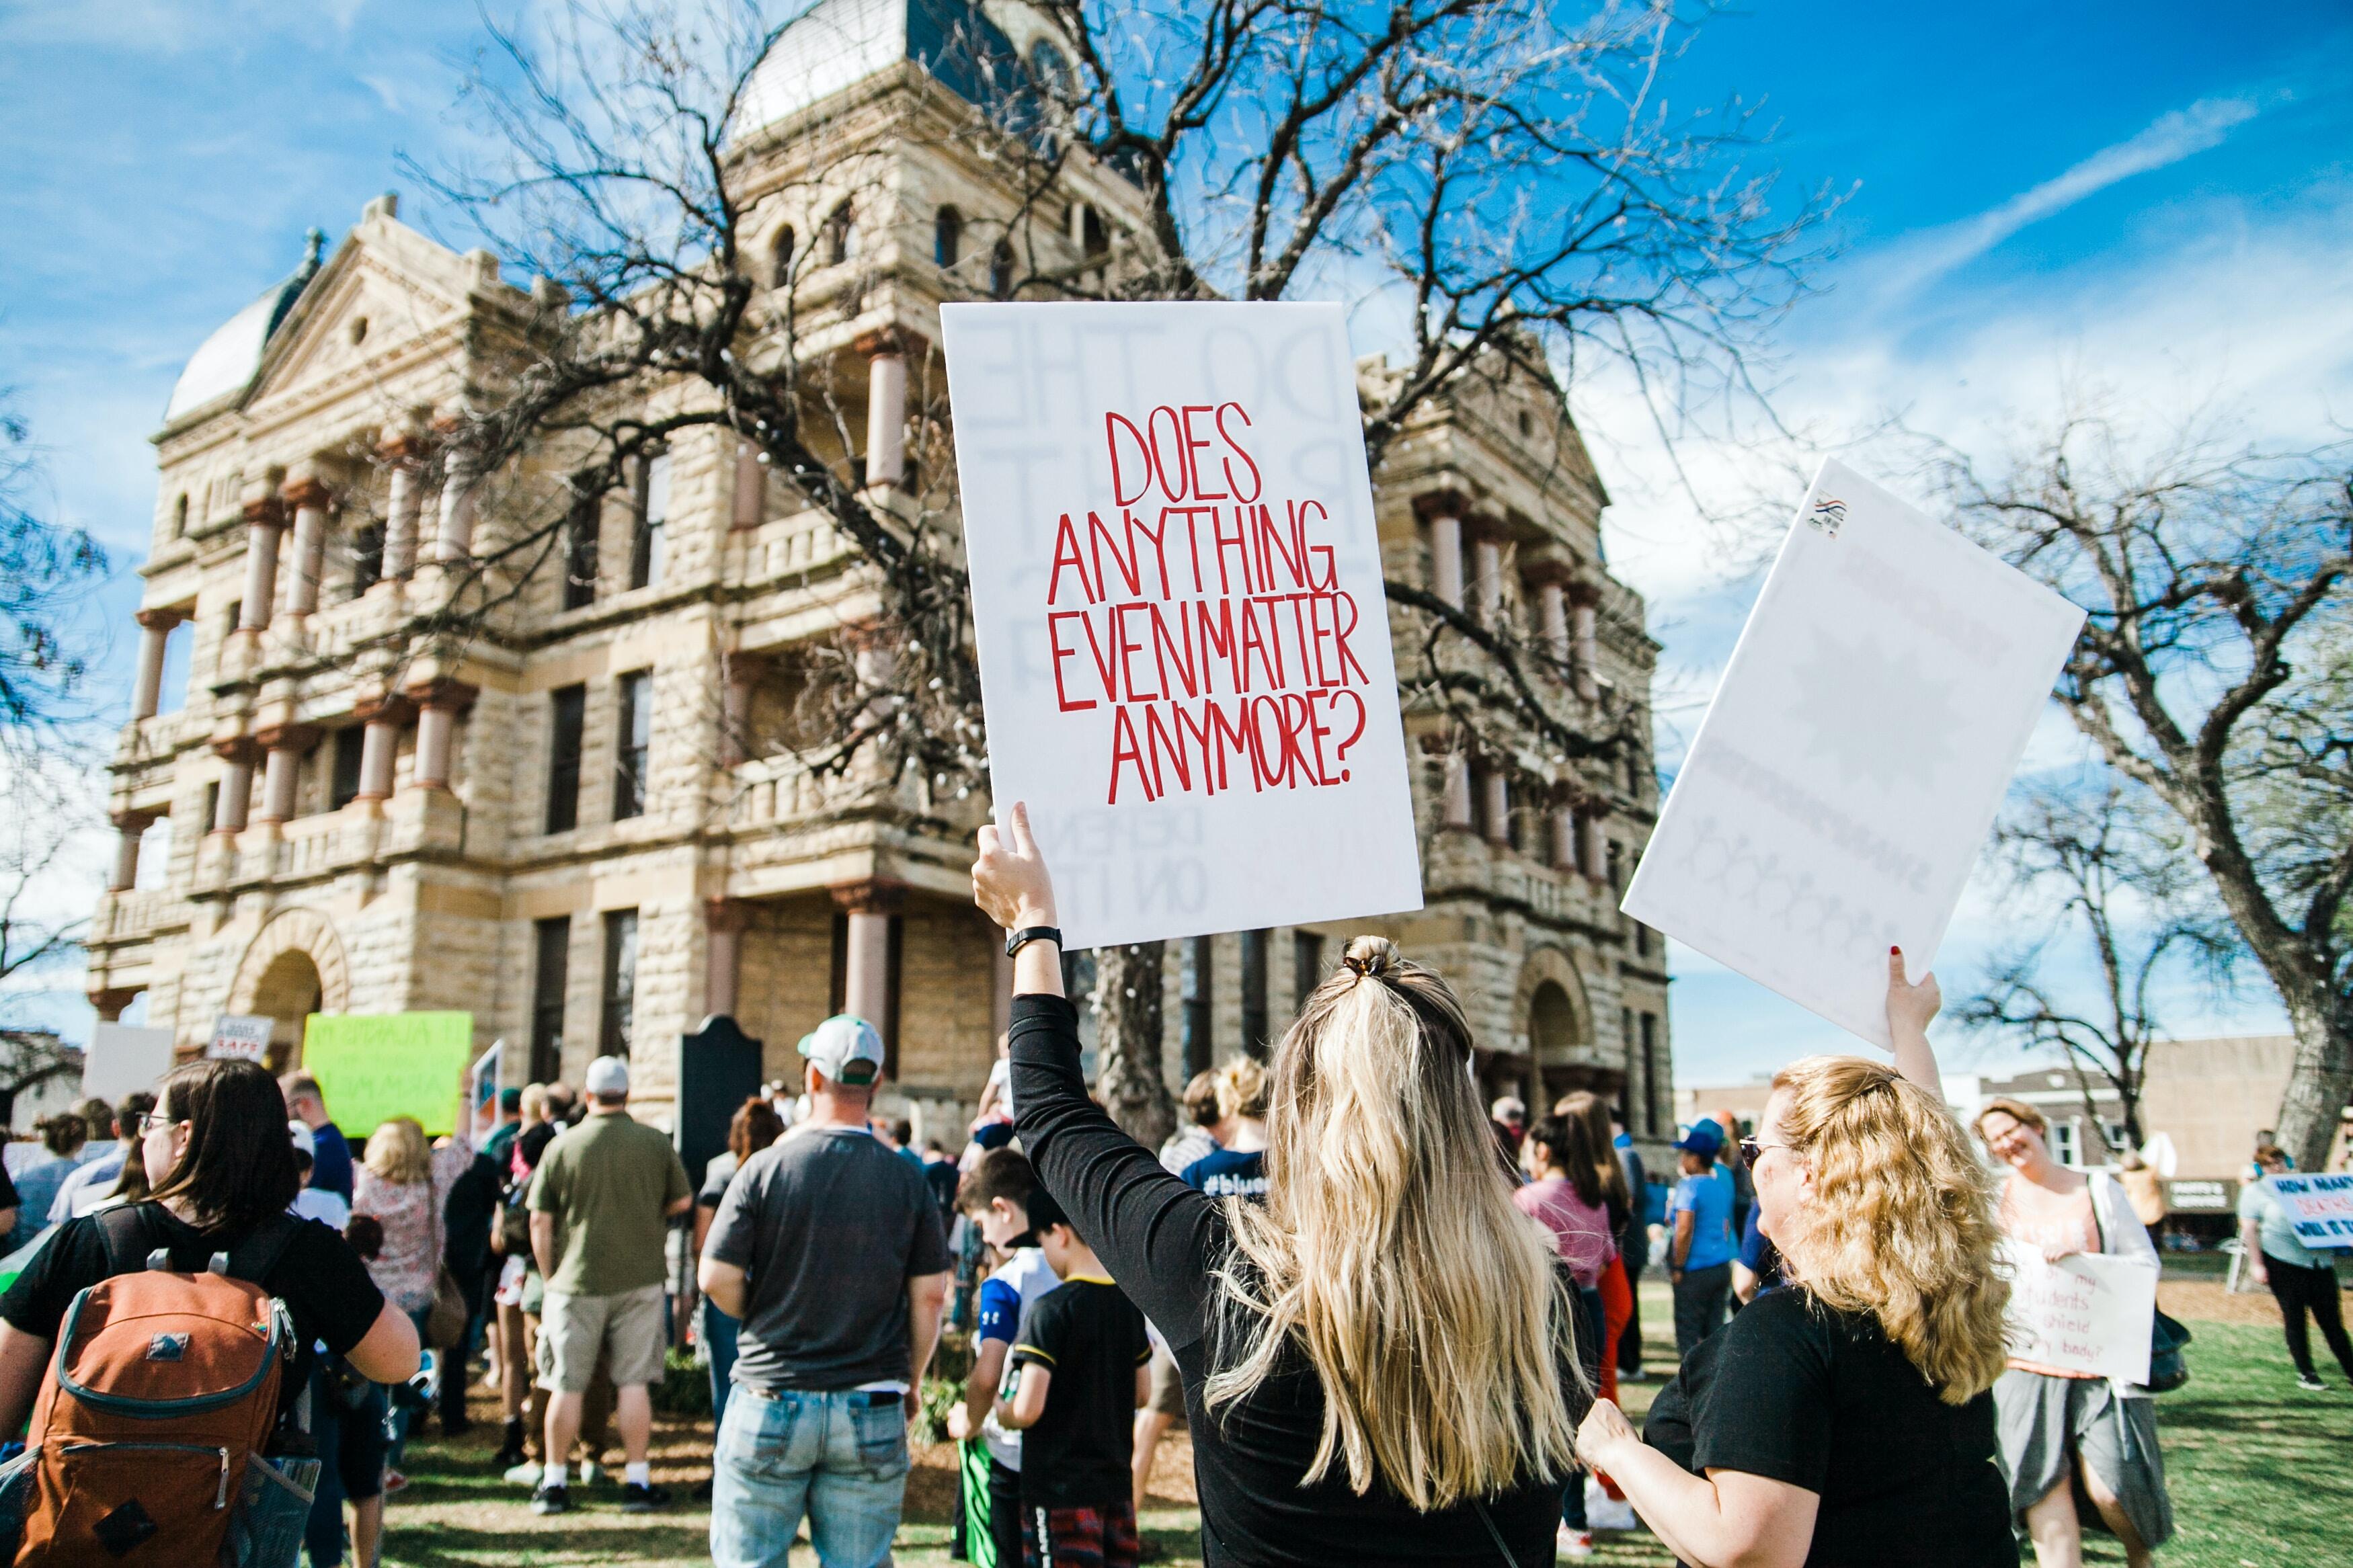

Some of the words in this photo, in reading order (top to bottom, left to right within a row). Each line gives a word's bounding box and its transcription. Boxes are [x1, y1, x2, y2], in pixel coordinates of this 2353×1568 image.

[1105, 402, 1262, 507] DOES
[1047, 500, 1338, 606] ANYTHING
[1047, 601, 1199, 712] EVEN
[1197, 591, 1370, 695] MATTER
[1107, 688, 1367, 805] ANYMORE?
